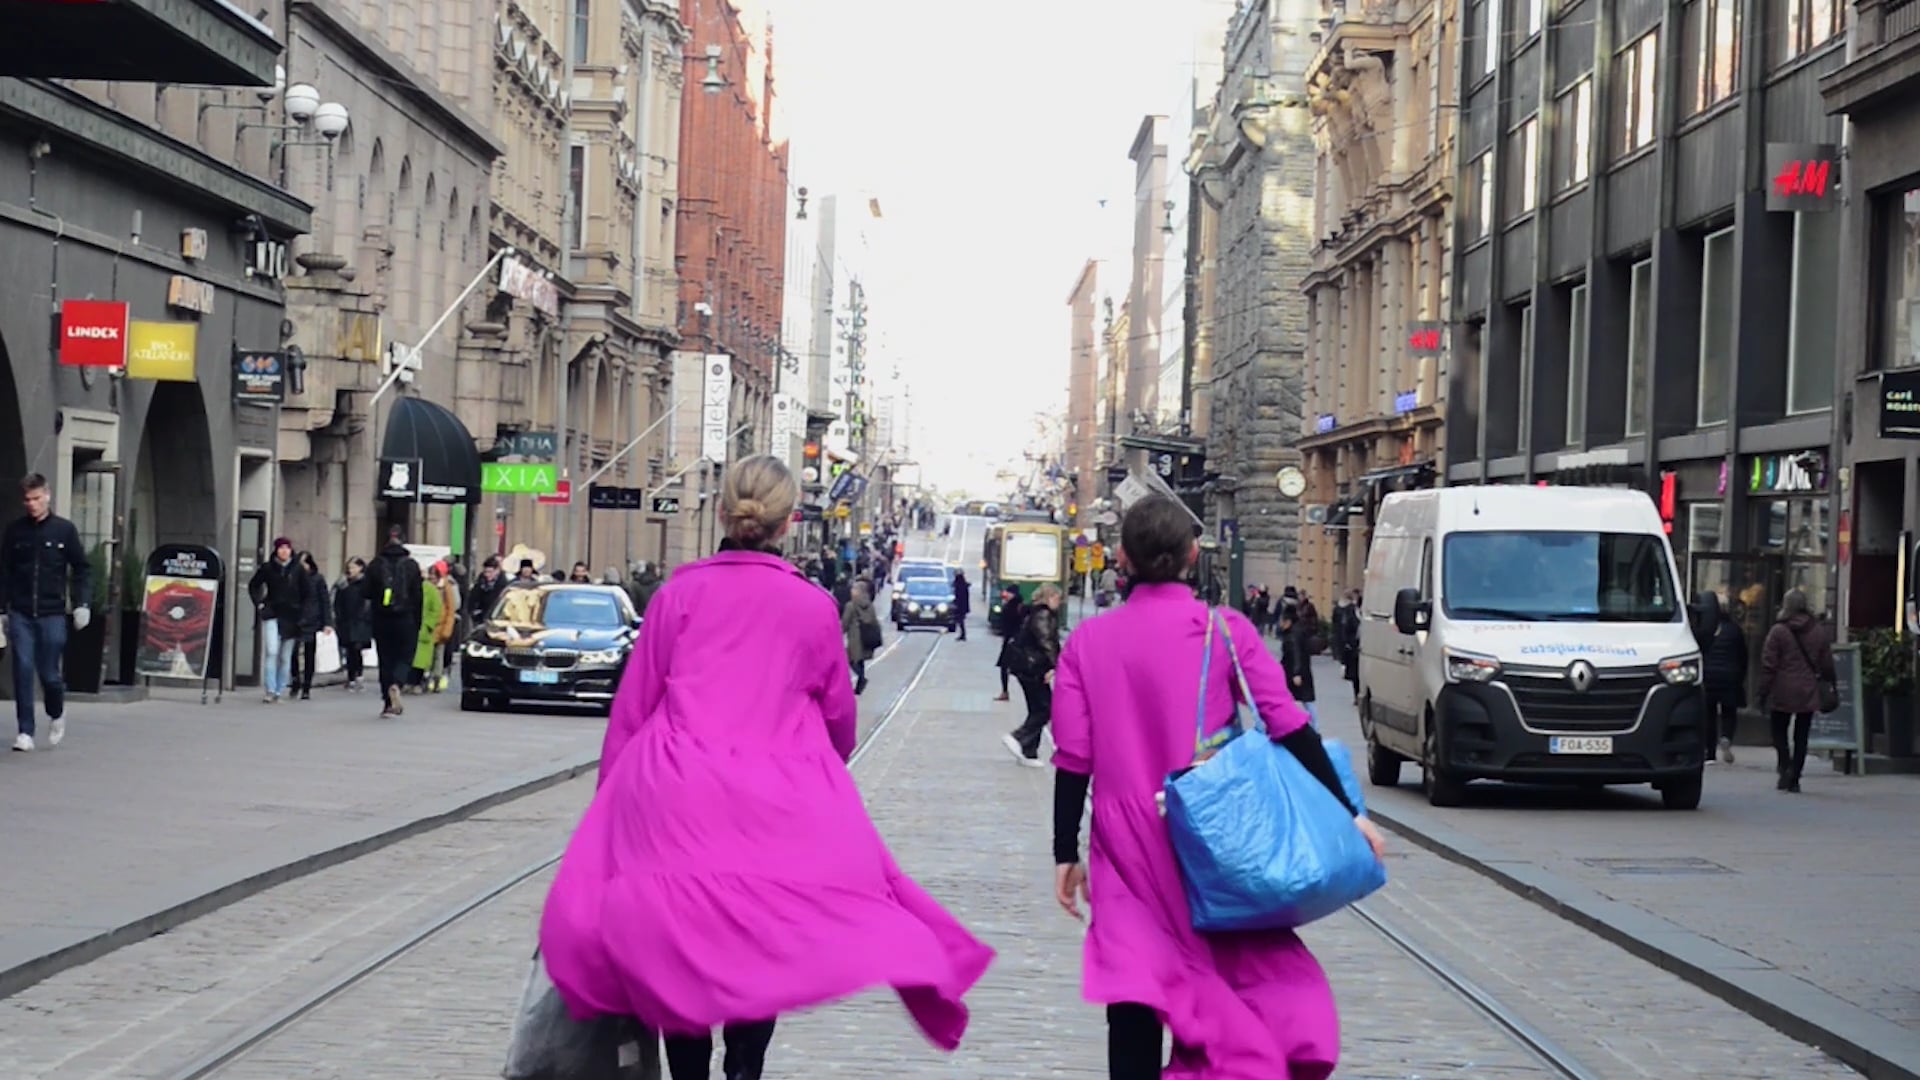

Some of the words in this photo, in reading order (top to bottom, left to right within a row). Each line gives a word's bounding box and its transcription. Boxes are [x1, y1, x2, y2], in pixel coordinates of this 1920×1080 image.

[1774, 159, 1830, 199] H&M
[67, 326, 119, 339] LINDEX
[1560, 738, 1609, 751] FOA-535
